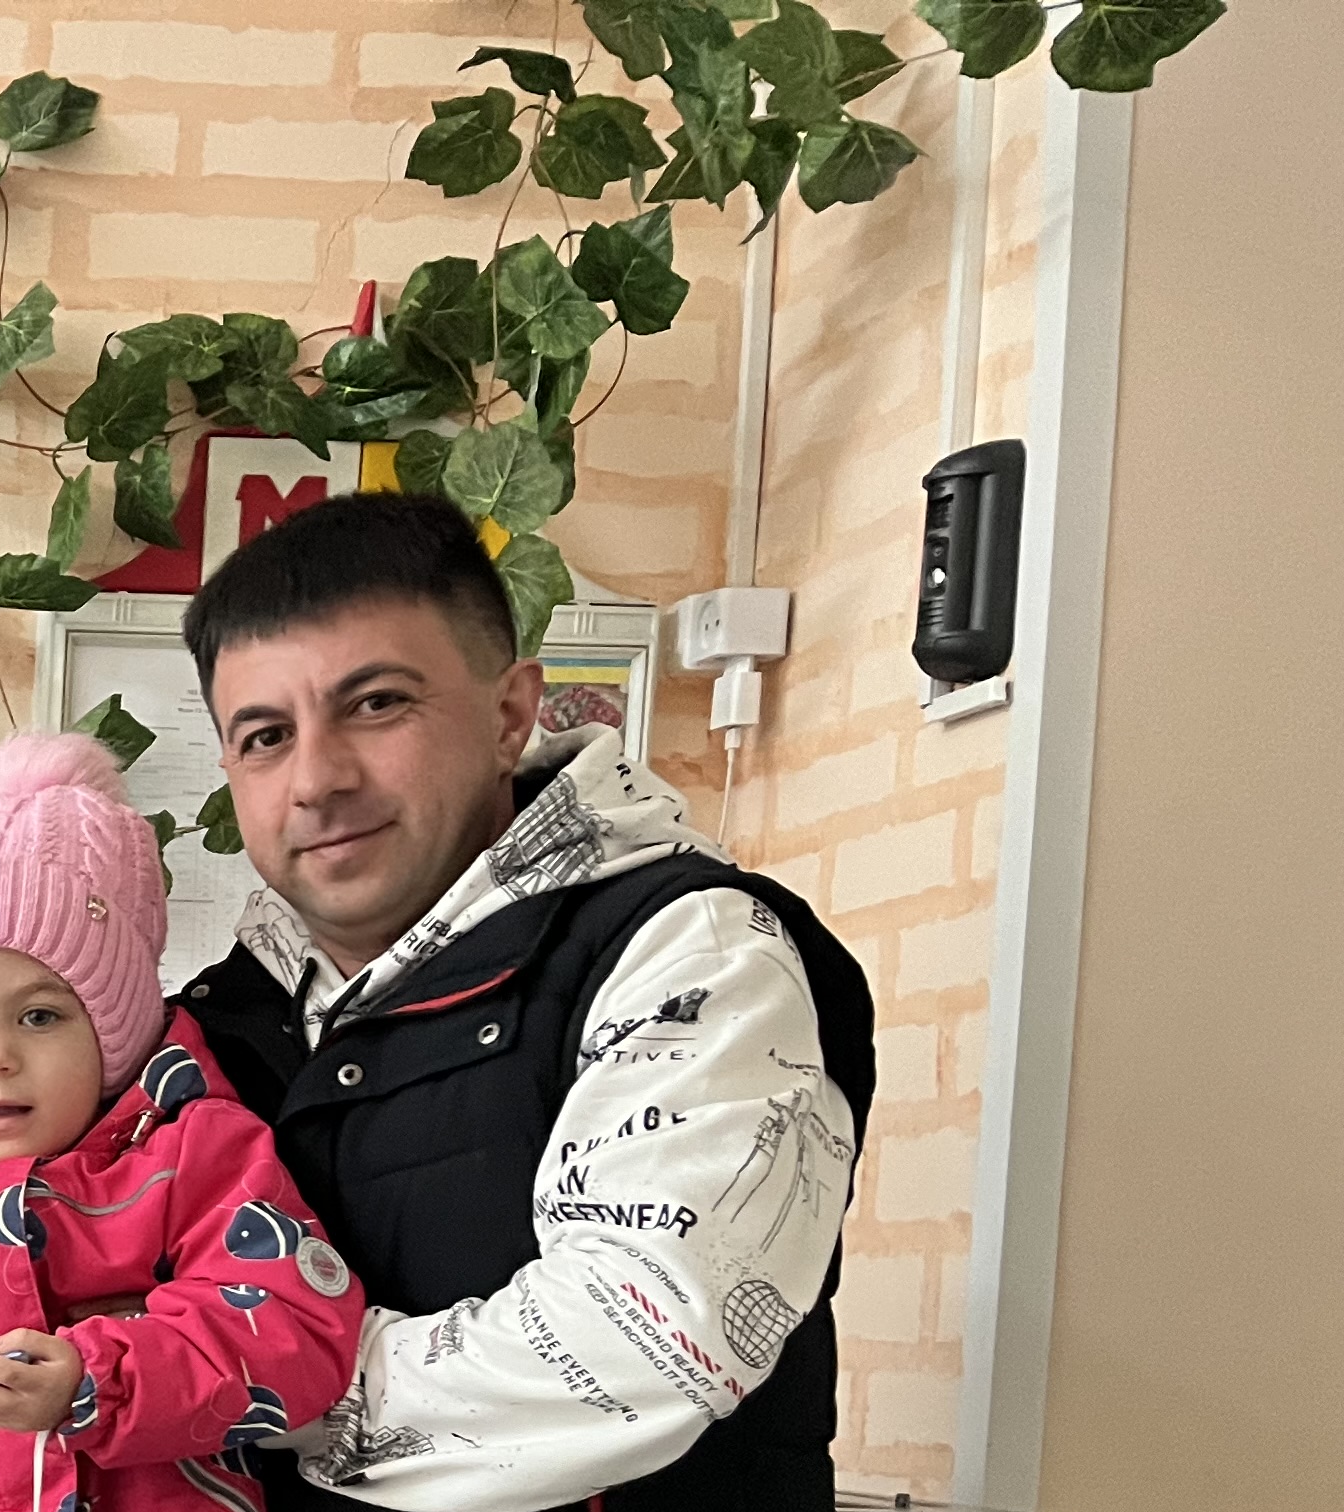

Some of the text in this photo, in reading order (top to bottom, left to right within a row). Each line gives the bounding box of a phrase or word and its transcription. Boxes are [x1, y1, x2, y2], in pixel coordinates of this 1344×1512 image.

[421, 914, 464, 940] URBA
[640, 1257, 691, 1304] NOTHING
[528, 1298, 562, 1351] CHANGE
[584, 1283, 610, 1304] KEEP
[603, 1305, 667, 1371] SEARCHING
[625, 1307, 672, 1353] BEYOND
[670, 1353, 719, 1392] REALITY
[528, 1336, 558, 1365] STAY
[559, 1369, 582, 1392] THE
